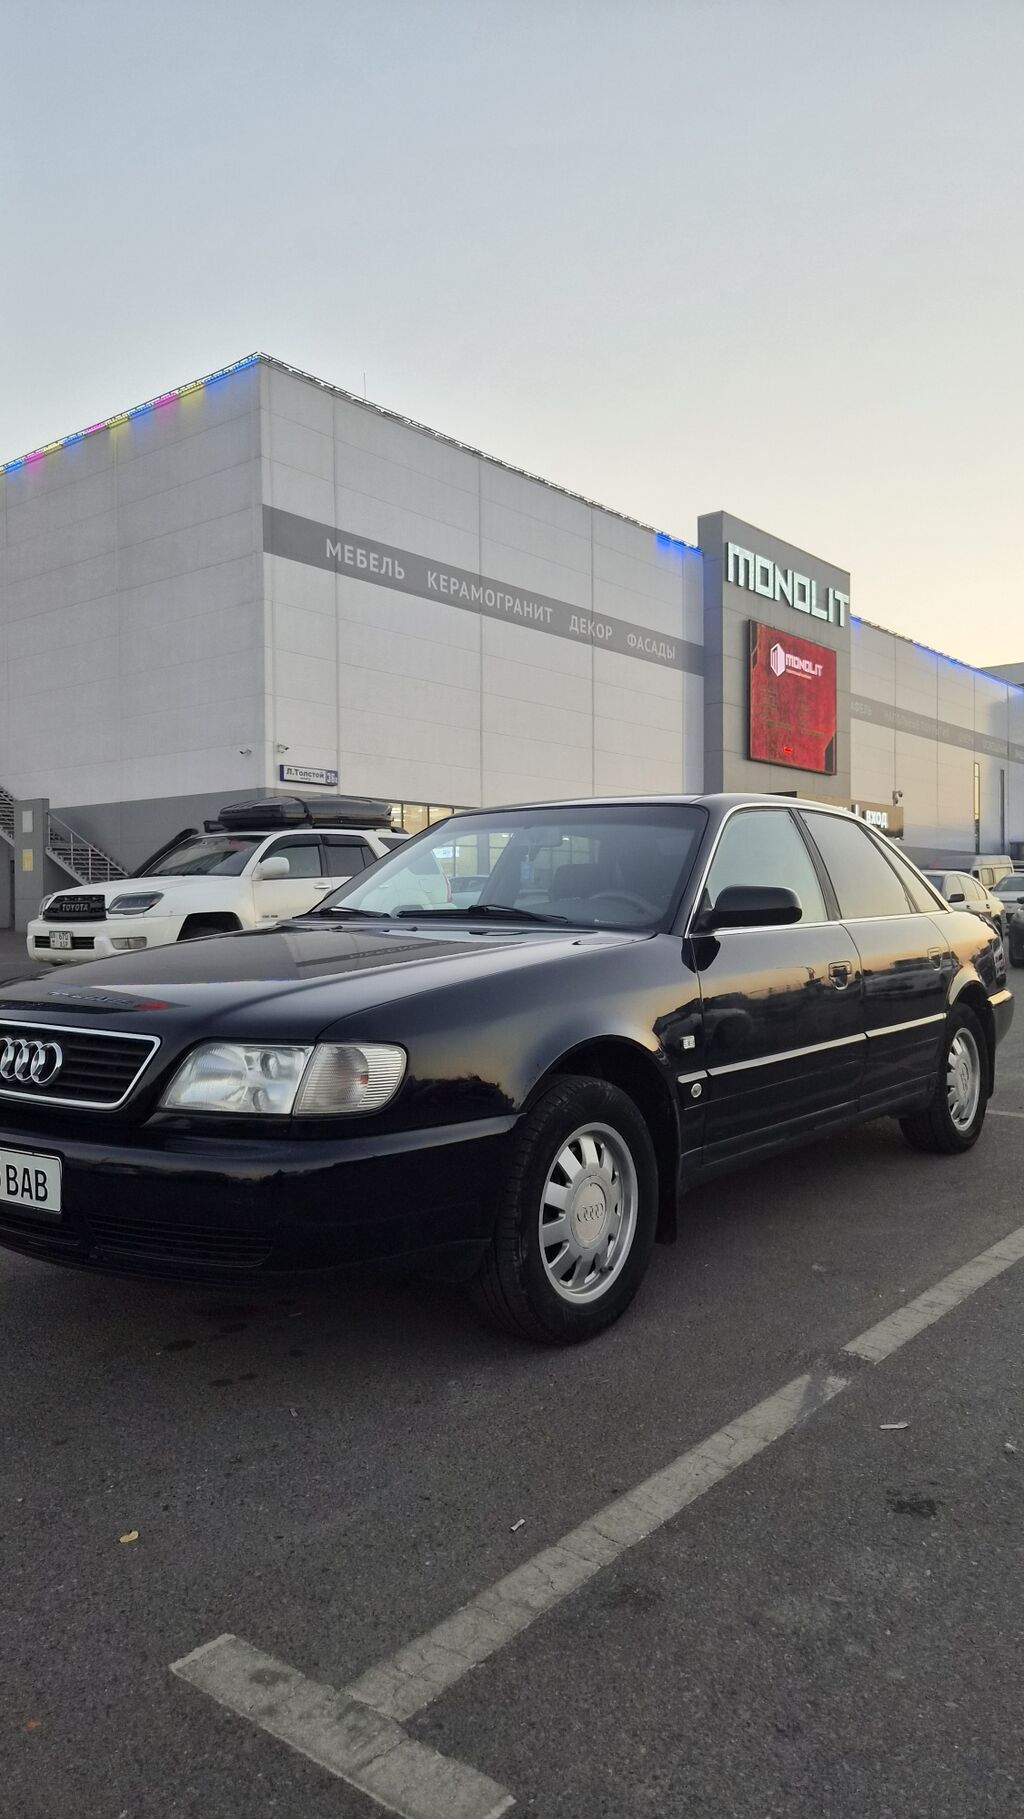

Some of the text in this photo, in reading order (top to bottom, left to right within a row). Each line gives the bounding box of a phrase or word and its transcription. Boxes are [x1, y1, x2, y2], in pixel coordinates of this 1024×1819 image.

[325, 537, 676, 661] МЕБЕЛЬ КЕРАМОГРАНИТ ДЕКОР ФАСАДЫ
[726, 541, 850, 627] MONOLIT
[785, 653, 823, 676] MONOLIT
[866, 810, 889, 829] ВХОД
[62, 903, 89, 912] TOYOTA
[5, 1163, 48, 1202] BAB
